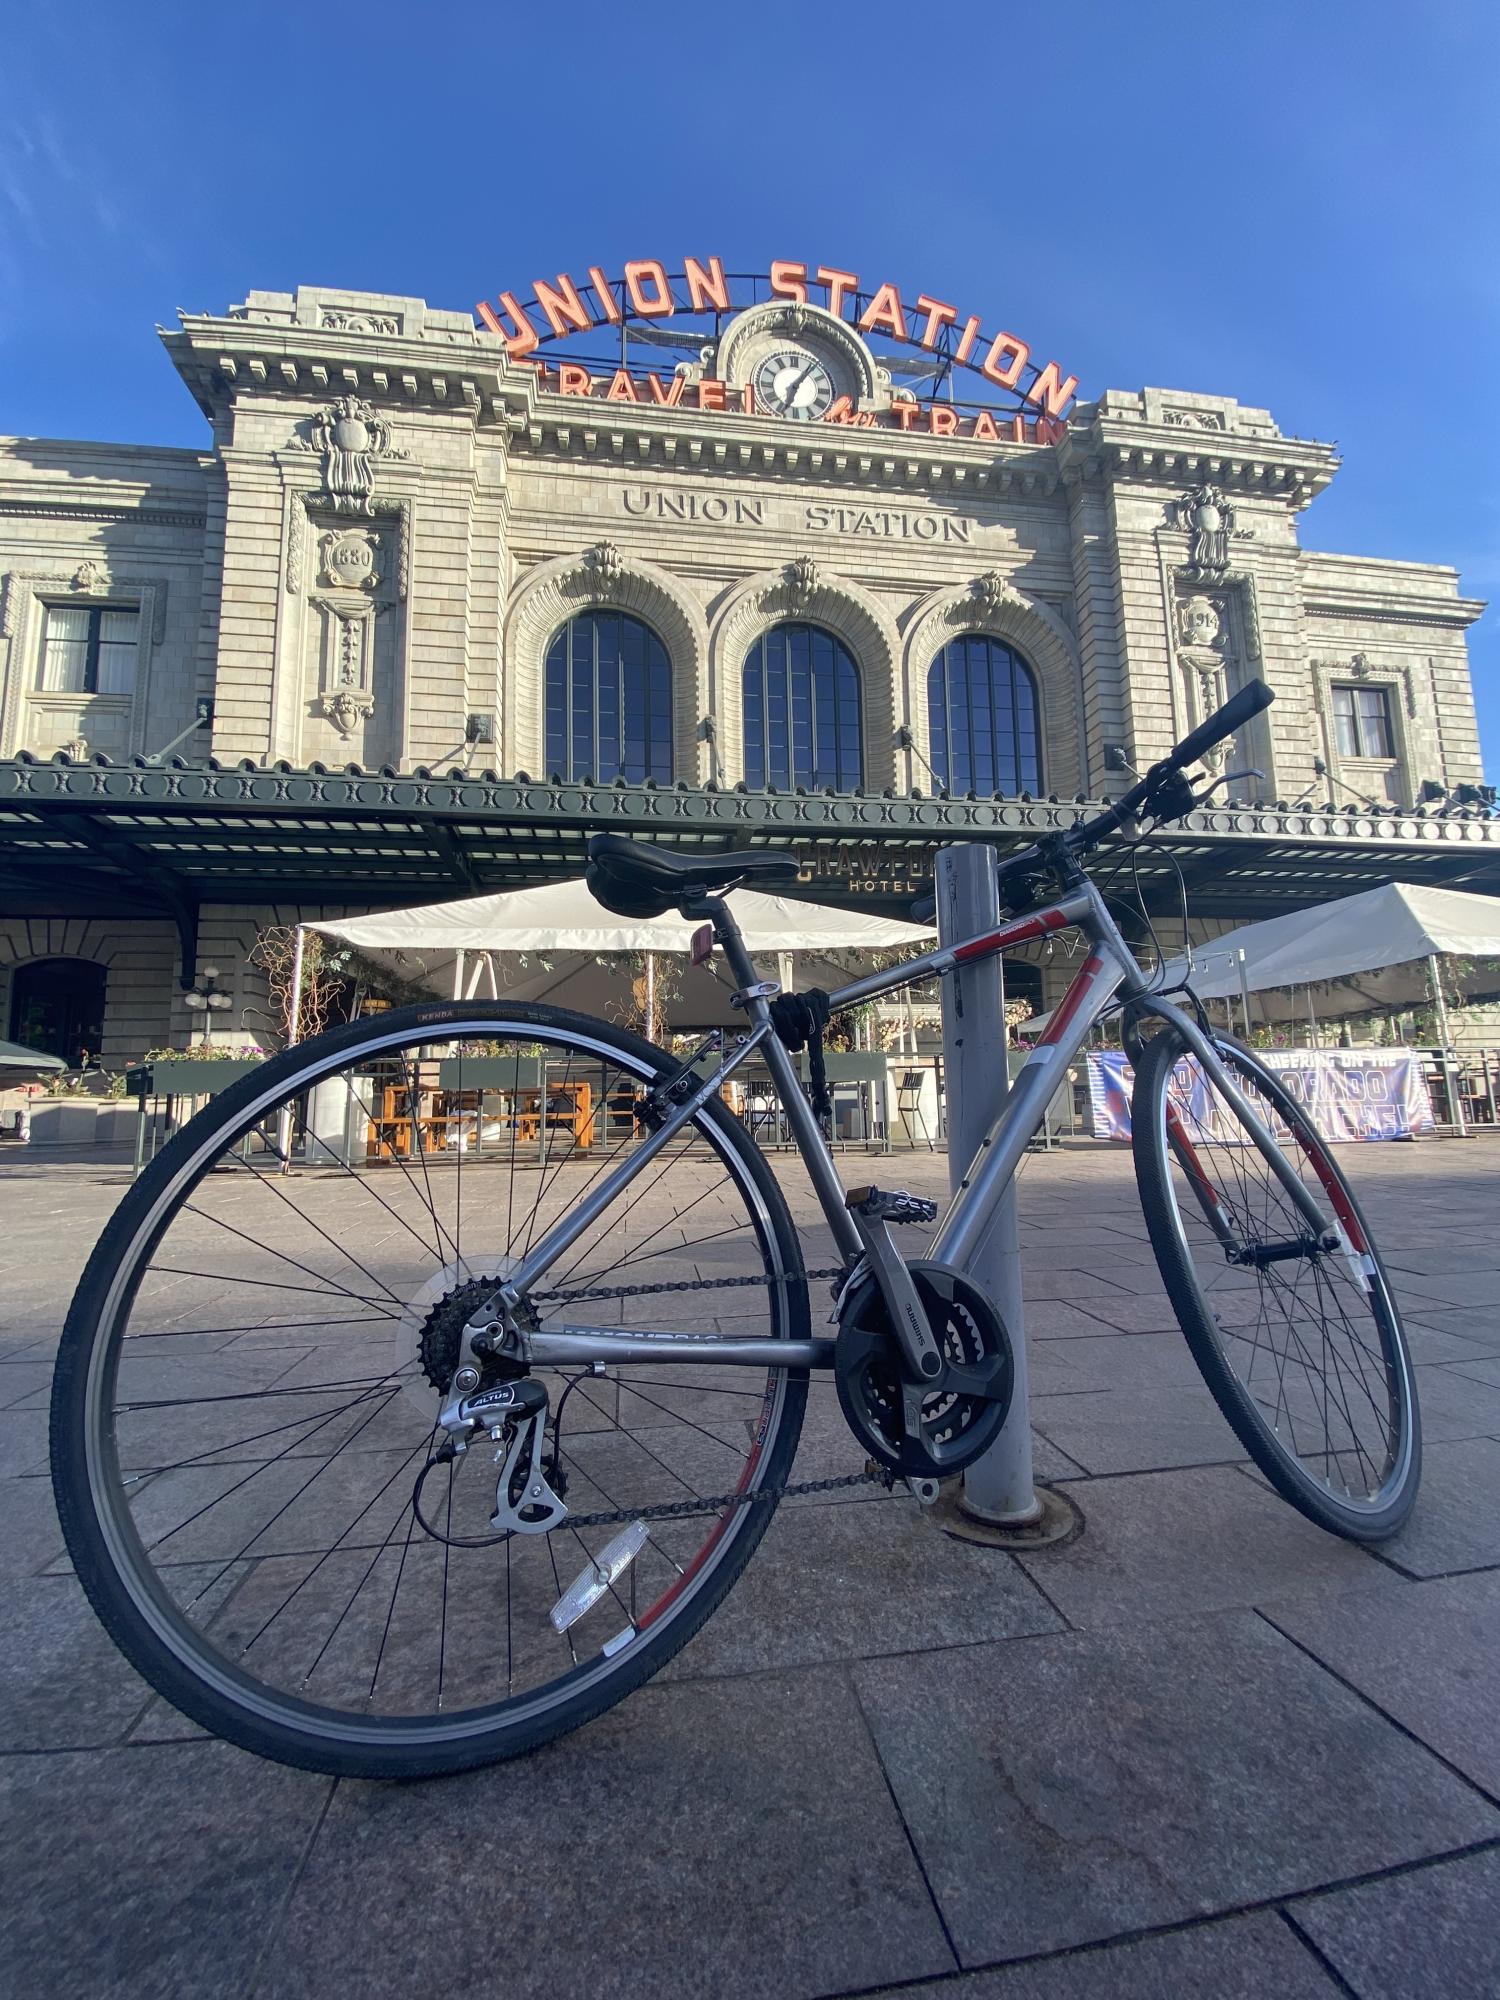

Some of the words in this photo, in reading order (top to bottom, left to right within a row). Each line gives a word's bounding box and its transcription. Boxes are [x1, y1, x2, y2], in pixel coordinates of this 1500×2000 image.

[475, 256, 731, 357] UNION
[771, 259, 1079, 419] STATION
[891, 400, 1068, 445] TRAIN
[623, 488, 763, 525] UNION
[806, 506, 970, 543] STATION
[335, 548, 370, 566] 1880
[1188, 612, 1218, 629] 1914
[796, 842, 936, 881] CRAWFO
[850, 880, 916, 892] HOTEL
[1342, 1052, 1364, 1067] ON
[1372, 1054, 1397, 1067] THE
[473, 1392, 509, 1407] ALTUS
